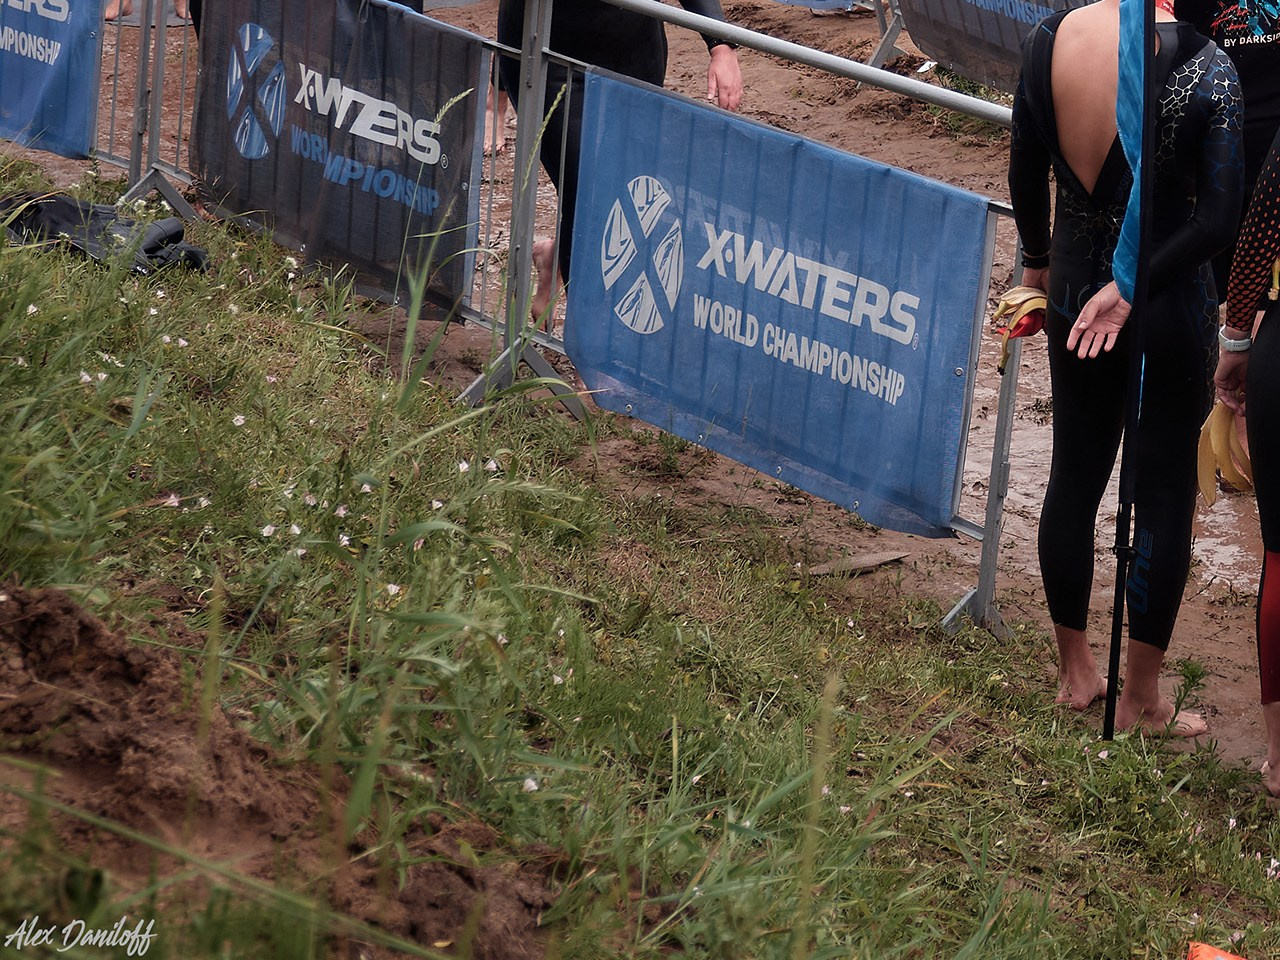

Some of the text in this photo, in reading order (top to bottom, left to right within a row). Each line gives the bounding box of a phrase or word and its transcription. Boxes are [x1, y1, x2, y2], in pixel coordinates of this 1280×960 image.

[1224, 38, 1237, 48] BY
[291, 124, 441, 216] WORL MPIONSHIP
[694, 293, 905, 406] WORLD CHAMPIONSHIP
